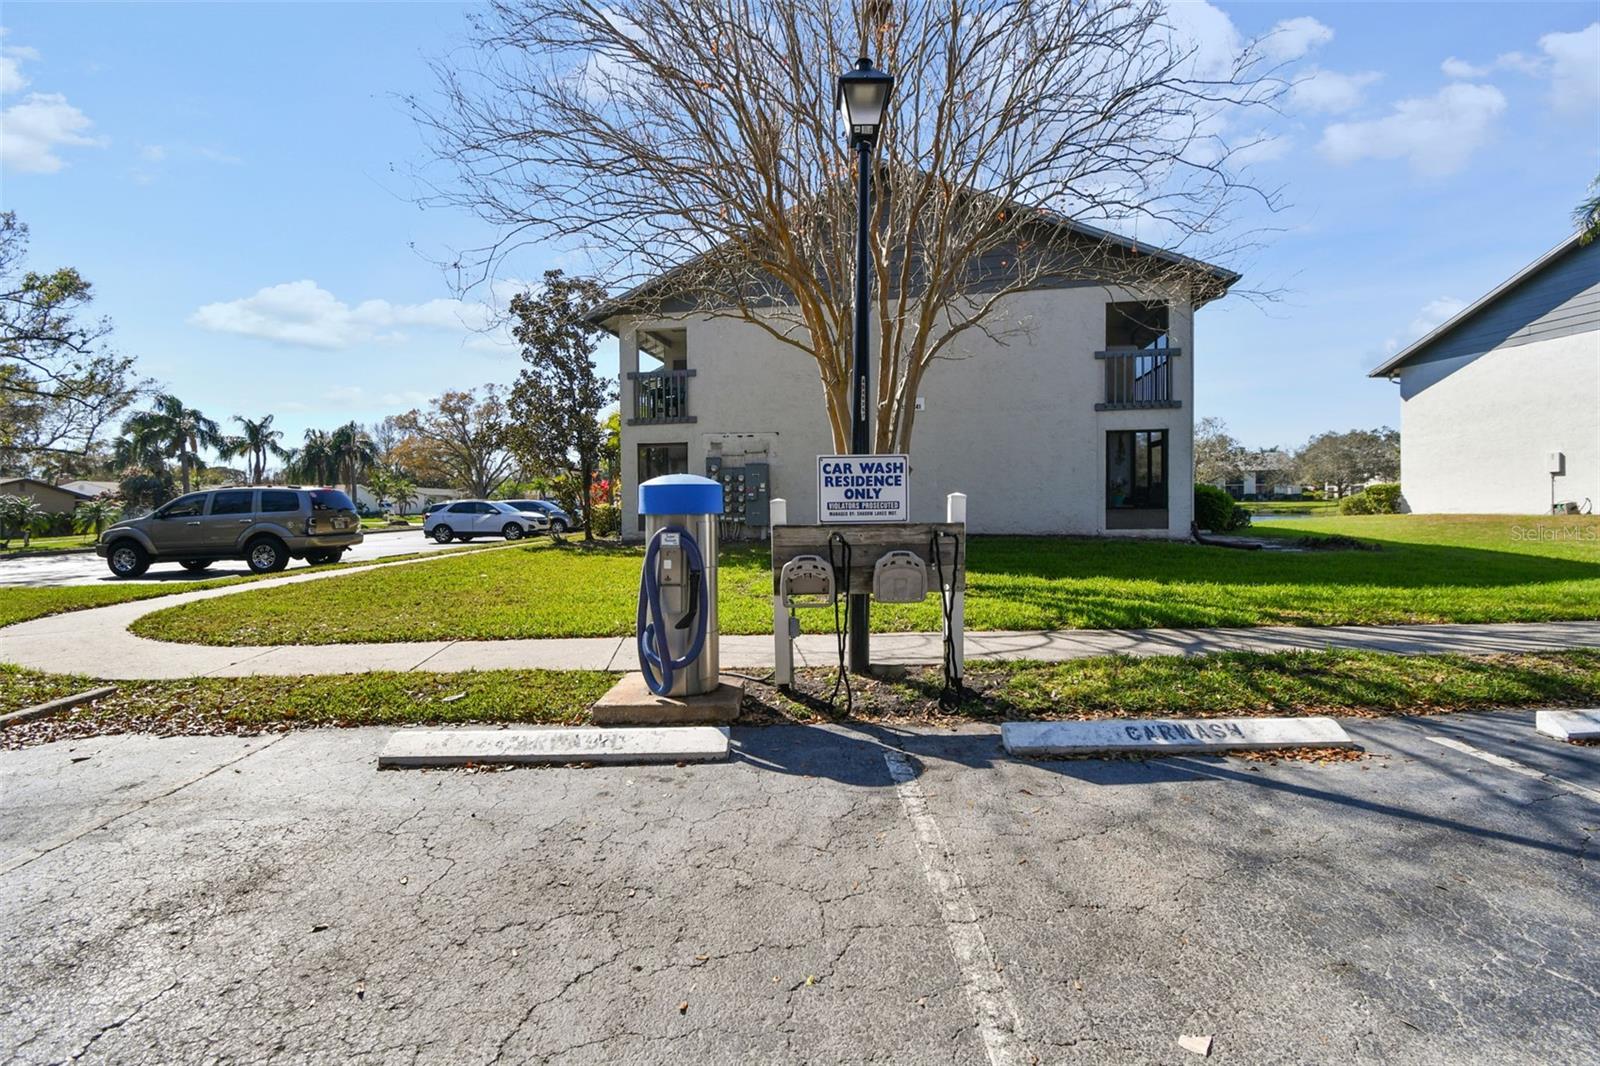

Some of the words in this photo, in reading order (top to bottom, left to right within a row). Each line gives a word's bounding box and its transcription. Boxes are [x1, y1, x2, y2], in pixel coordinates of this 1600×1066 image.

[822, 463, 853, 474] CAR
[859, 462, 904, 474] WASH
[824, 475, 902, 487] RESIDENCE
[844, 488, 882, 500] ONLY
[828, 502, 858, 510] VIOLATORS
